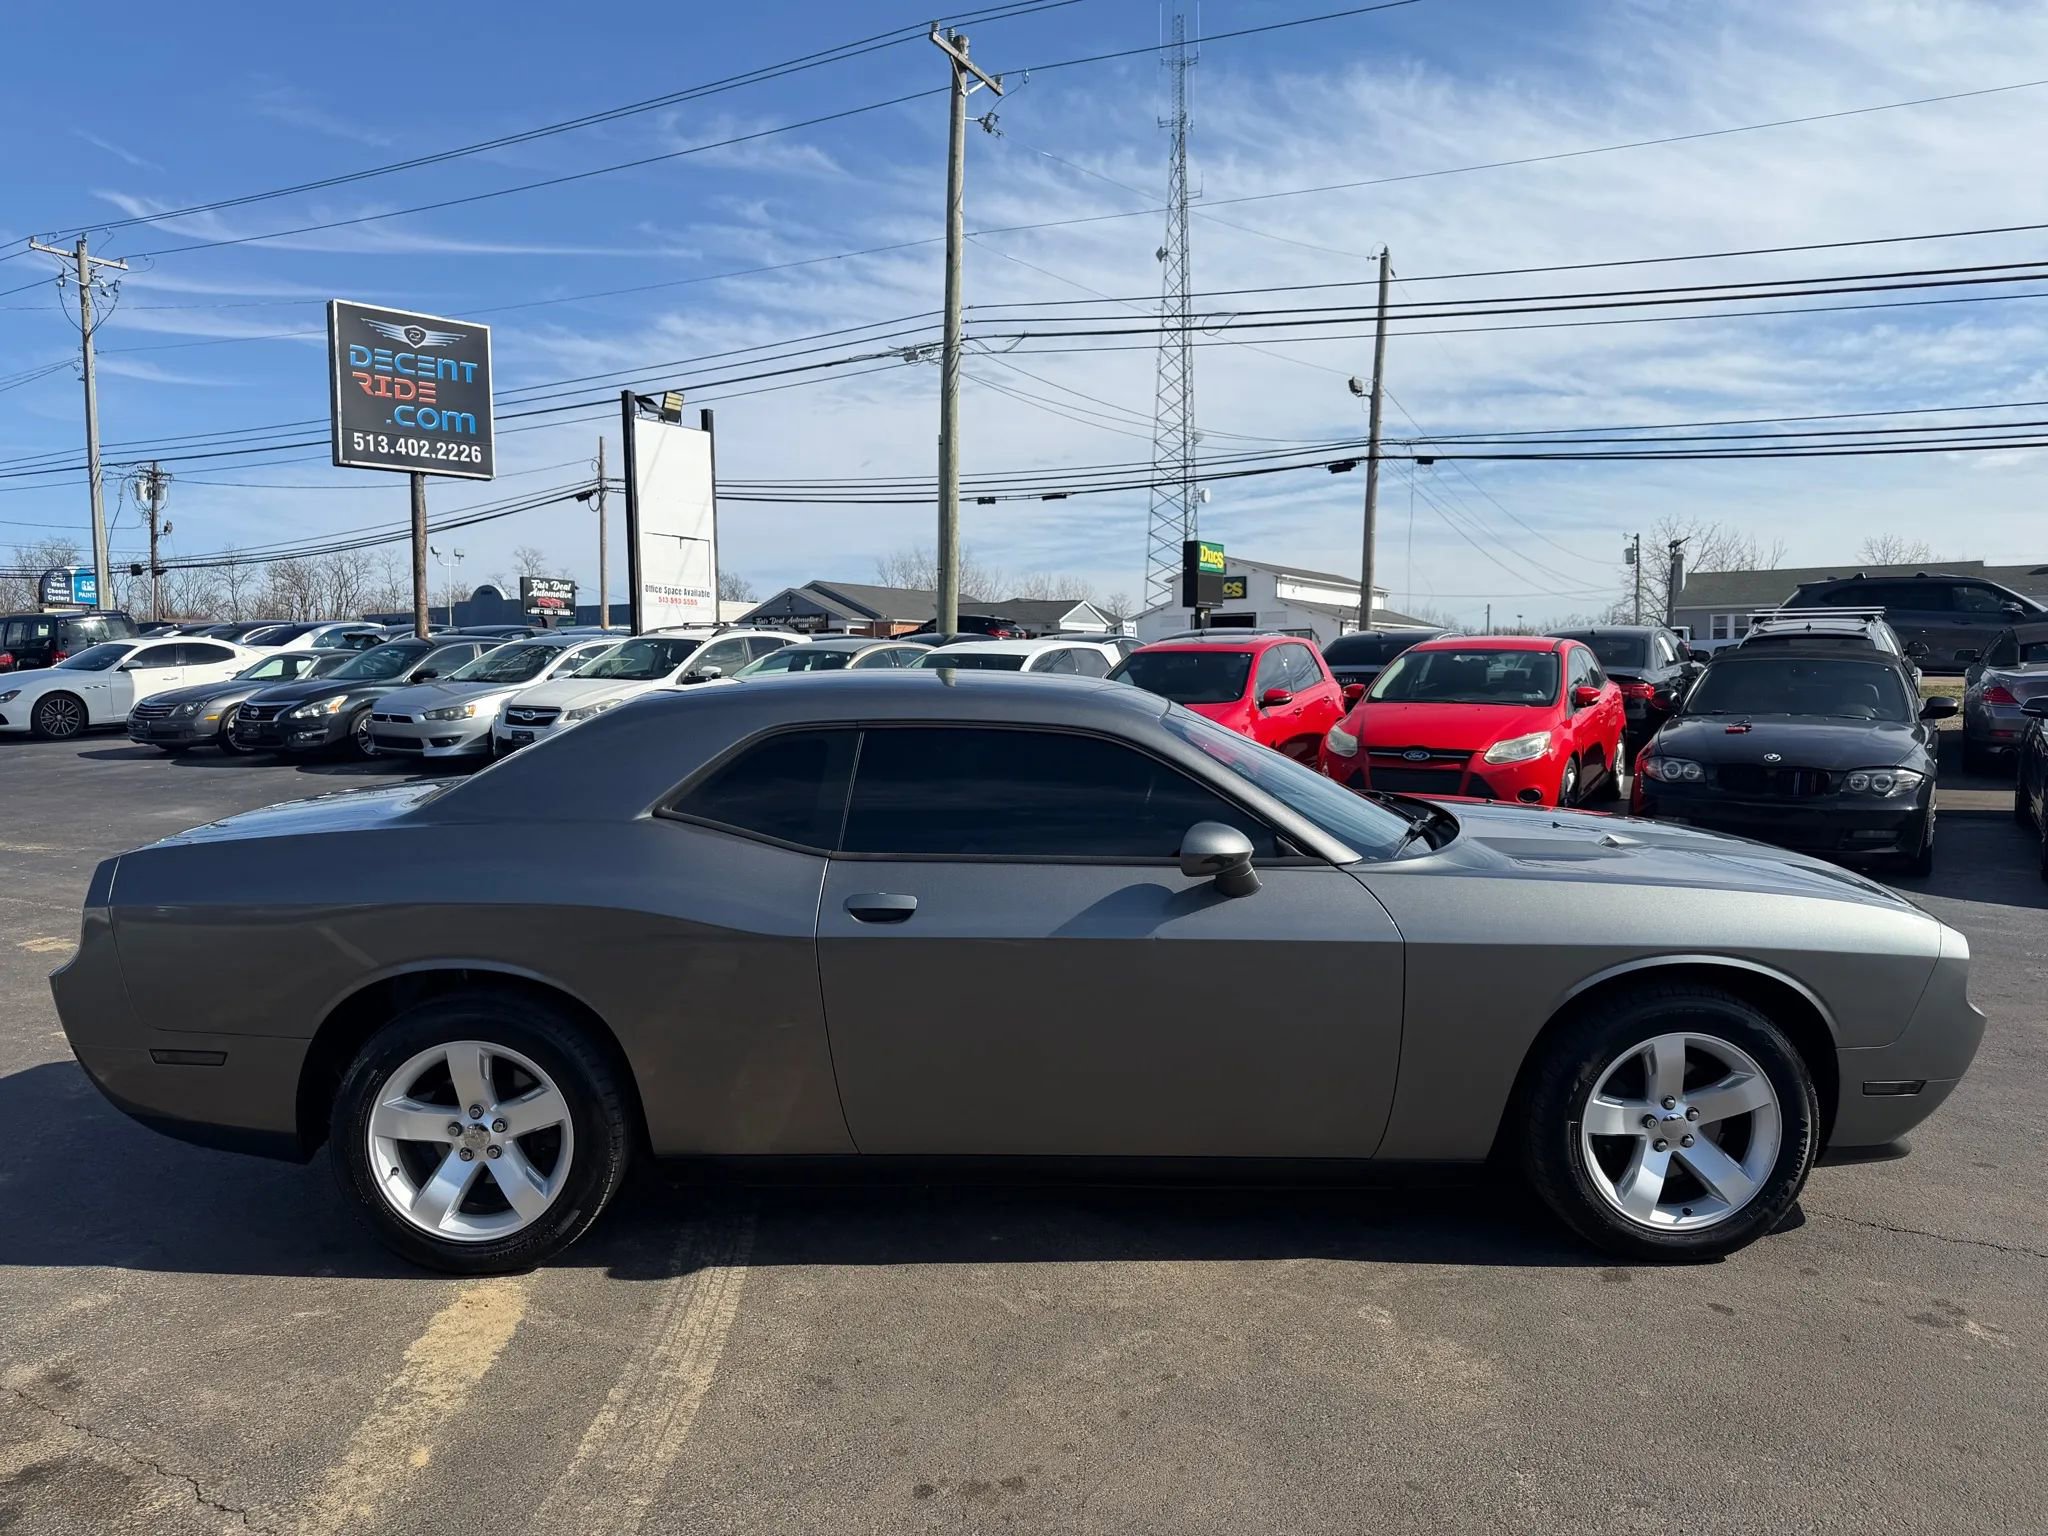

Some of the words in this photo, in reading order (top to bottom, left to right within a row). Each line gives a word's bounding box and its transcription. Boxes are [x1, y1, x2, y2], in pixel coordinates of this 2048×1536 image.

[350, 344, 478, 384] DECENT
[352, 371, 437, 404] RIDE
[353, 432, 482, 463] 513.402.2226
[47, 587, 70, 595] Chester
[531, 580, 549, 590] Fair
[550, 581, 572, 591] Deal
[645, 584, 662, 593] Office
[664, 586, 682, 596] Space
[683, 588, 710, 598] Available
[47, 594, 70, 602] Cyclery
[528, 588, 573, 599] Automotive
